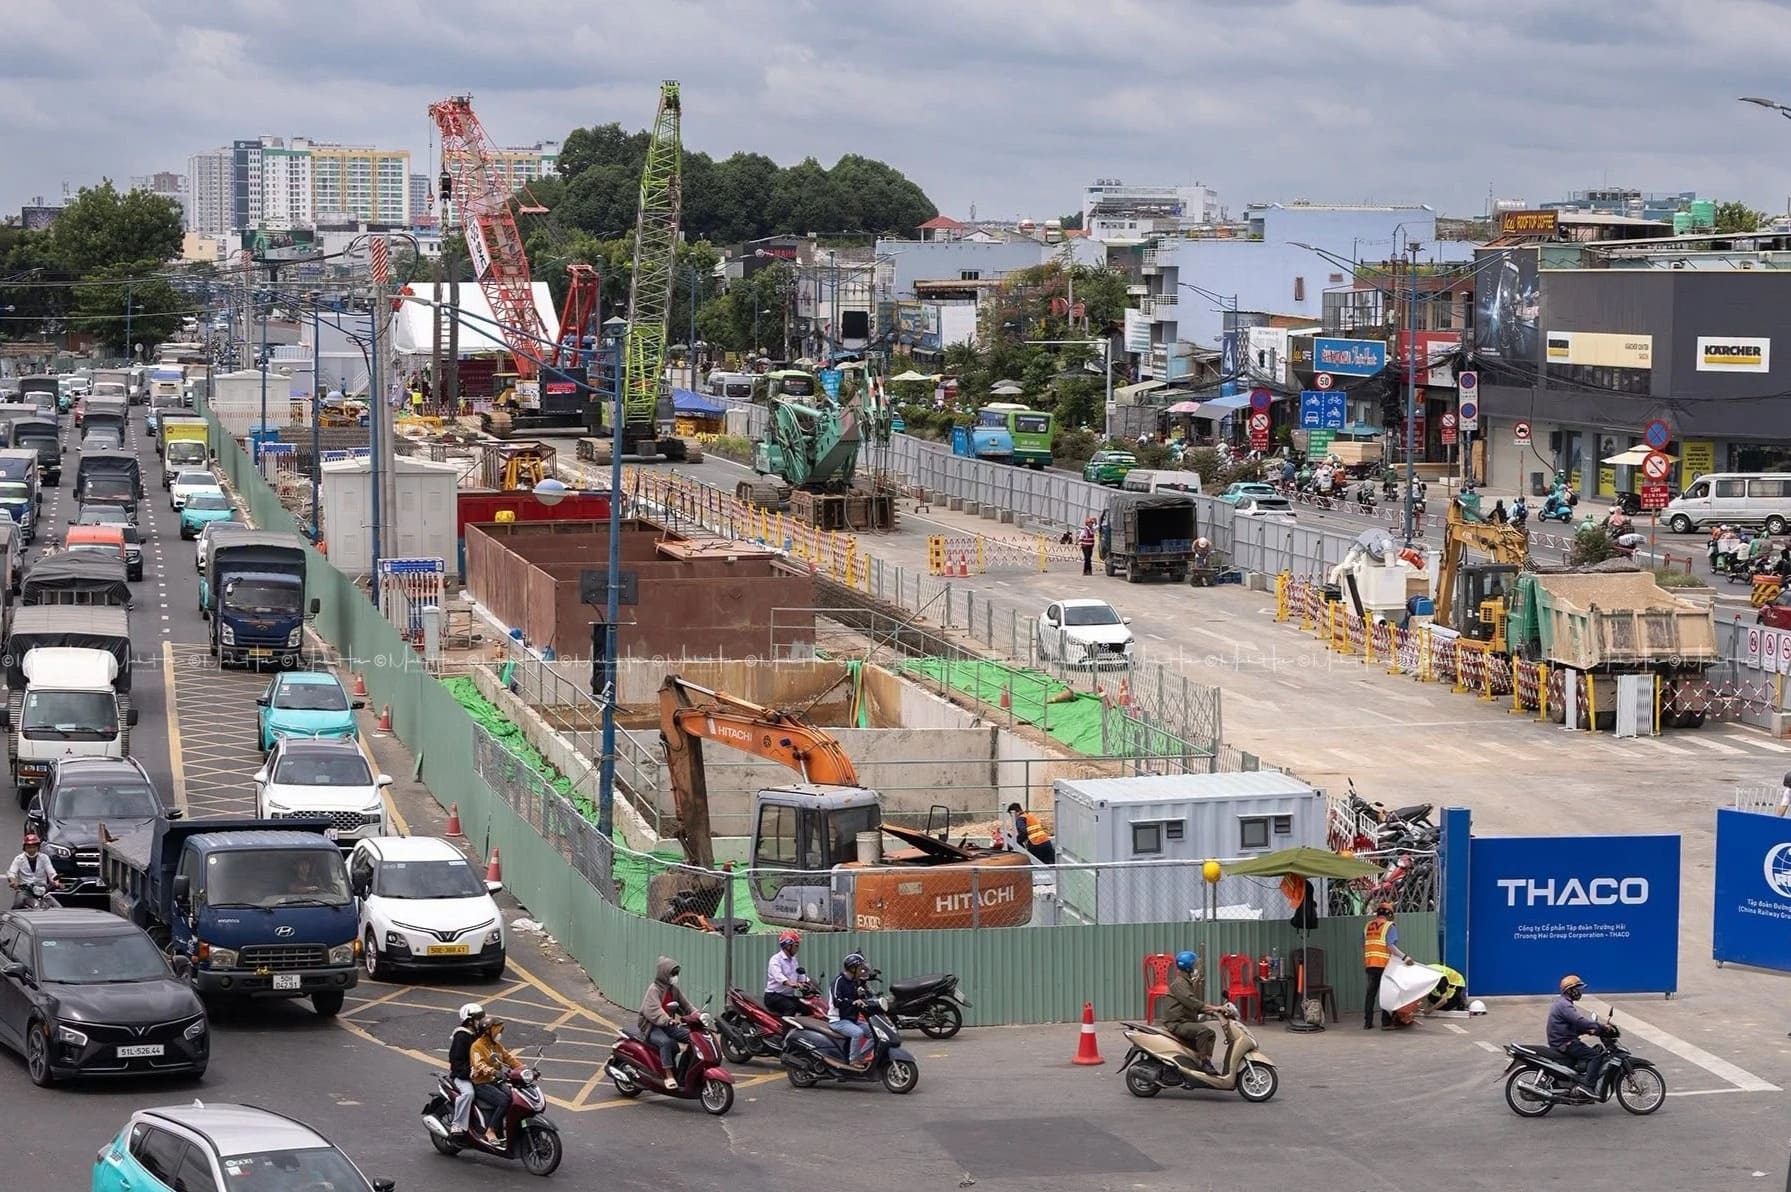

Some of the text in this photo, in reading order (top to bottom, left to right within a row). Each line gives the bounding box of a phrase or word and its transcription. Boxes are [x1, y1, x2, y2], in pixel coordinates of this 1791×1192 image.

[1319, 376, 1330, 386] 50
[717, 725, 753, 742] HITACHI
[1496, 877, 1649, 907] THACO
[935, 885, 1015, 913] HITACHI
[1738, 904, 1757, 914] (China
[1757, 908, 1780, 919] Railway
[1518, 924, 1534, 932] Công
[1549, 932, 1568, 940] Group
[1568, 931, 1605, 940] Corporation
[120, 1047, 161, 1056] 51L-526.44
